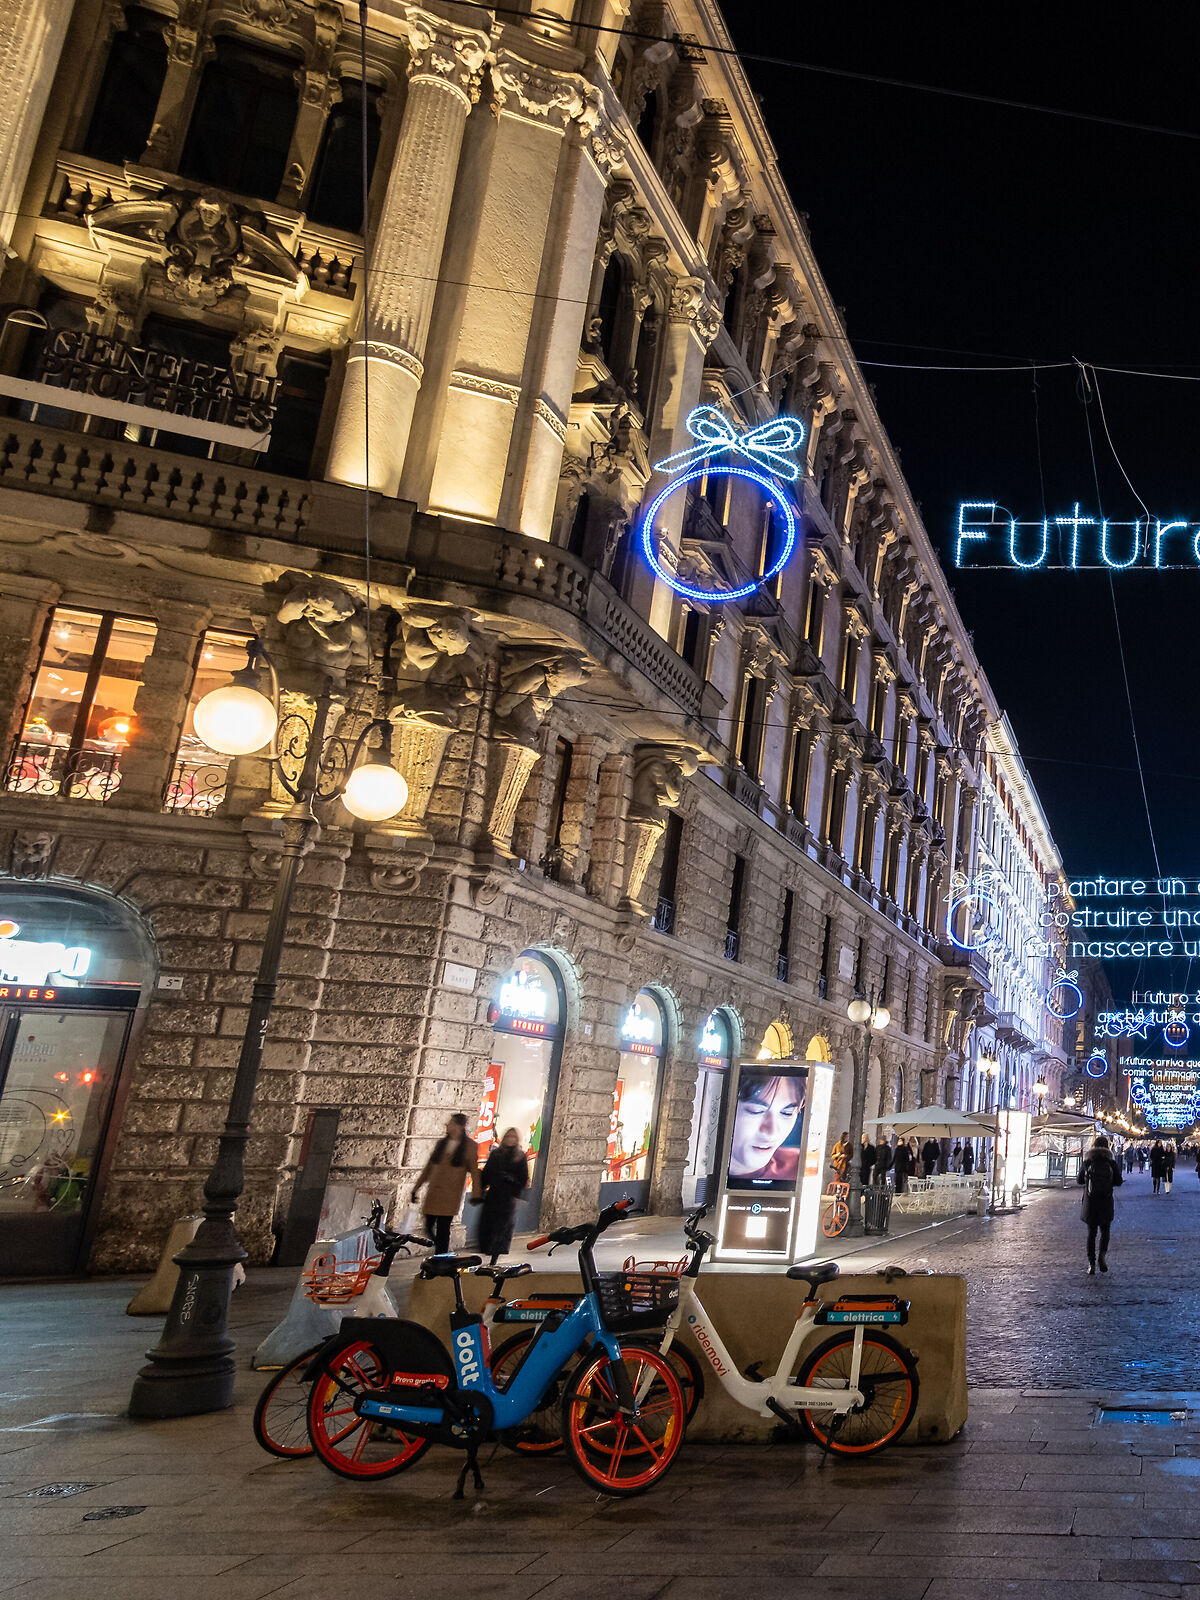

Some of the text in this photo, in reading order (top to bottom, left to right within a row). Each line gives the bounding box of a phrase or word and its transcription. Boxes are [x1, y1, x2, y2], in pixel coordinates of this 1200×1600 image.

[46, 330, 283, 403] GENERALI
[40, 356, 278, 435] PROPERTIES
[1047, 875, 1147, 899] piantare
[1157, 879, 1187, 896] un
[1039, 906, 1153, 928] costruire
[1072, 940, 1174, 958] nascere
[511, 1019, 546, 1033] STORIES
[842, 1312, 885, 1321] elettrica
[456, 1331, 480, 1387] dott
[692, 1323, 731, 1378] ridemovi
[394, 1375, 414, 1385] Prova
